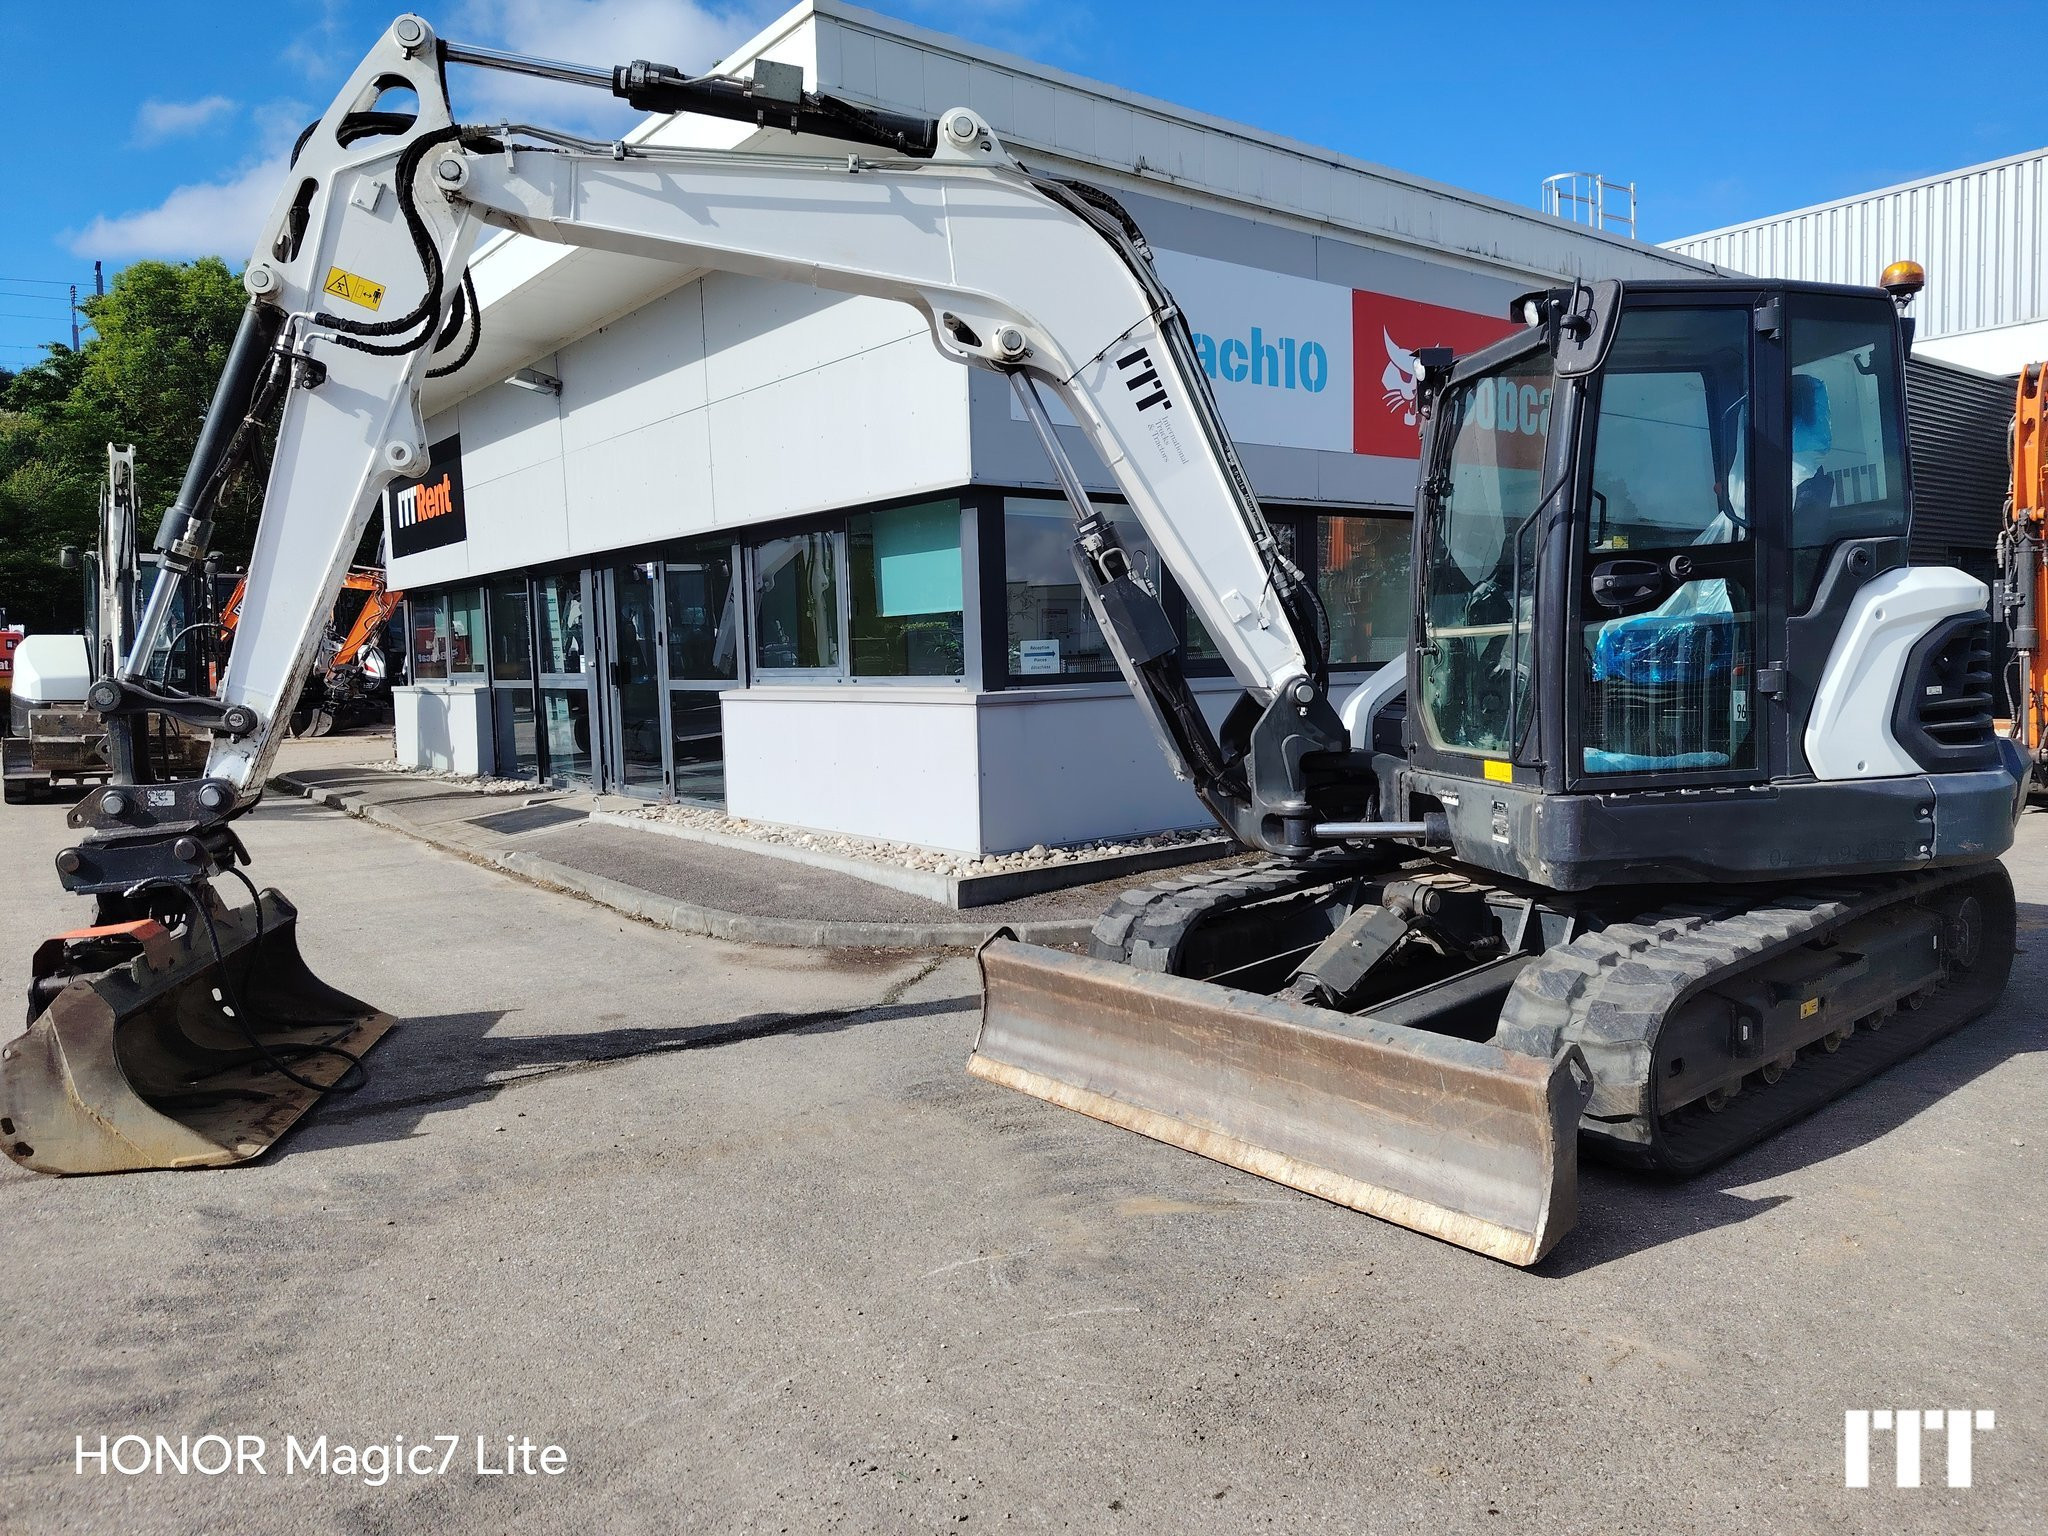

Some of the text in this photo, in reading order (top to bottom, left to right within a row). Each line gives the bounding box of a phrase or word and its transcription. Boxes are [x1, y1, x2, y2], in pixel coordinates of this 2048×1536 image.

[1155, 419, 1169, 446] Trucks
[1161, 416, 1189, 464] International
[1151, 433, 1168, 463] Tractors
